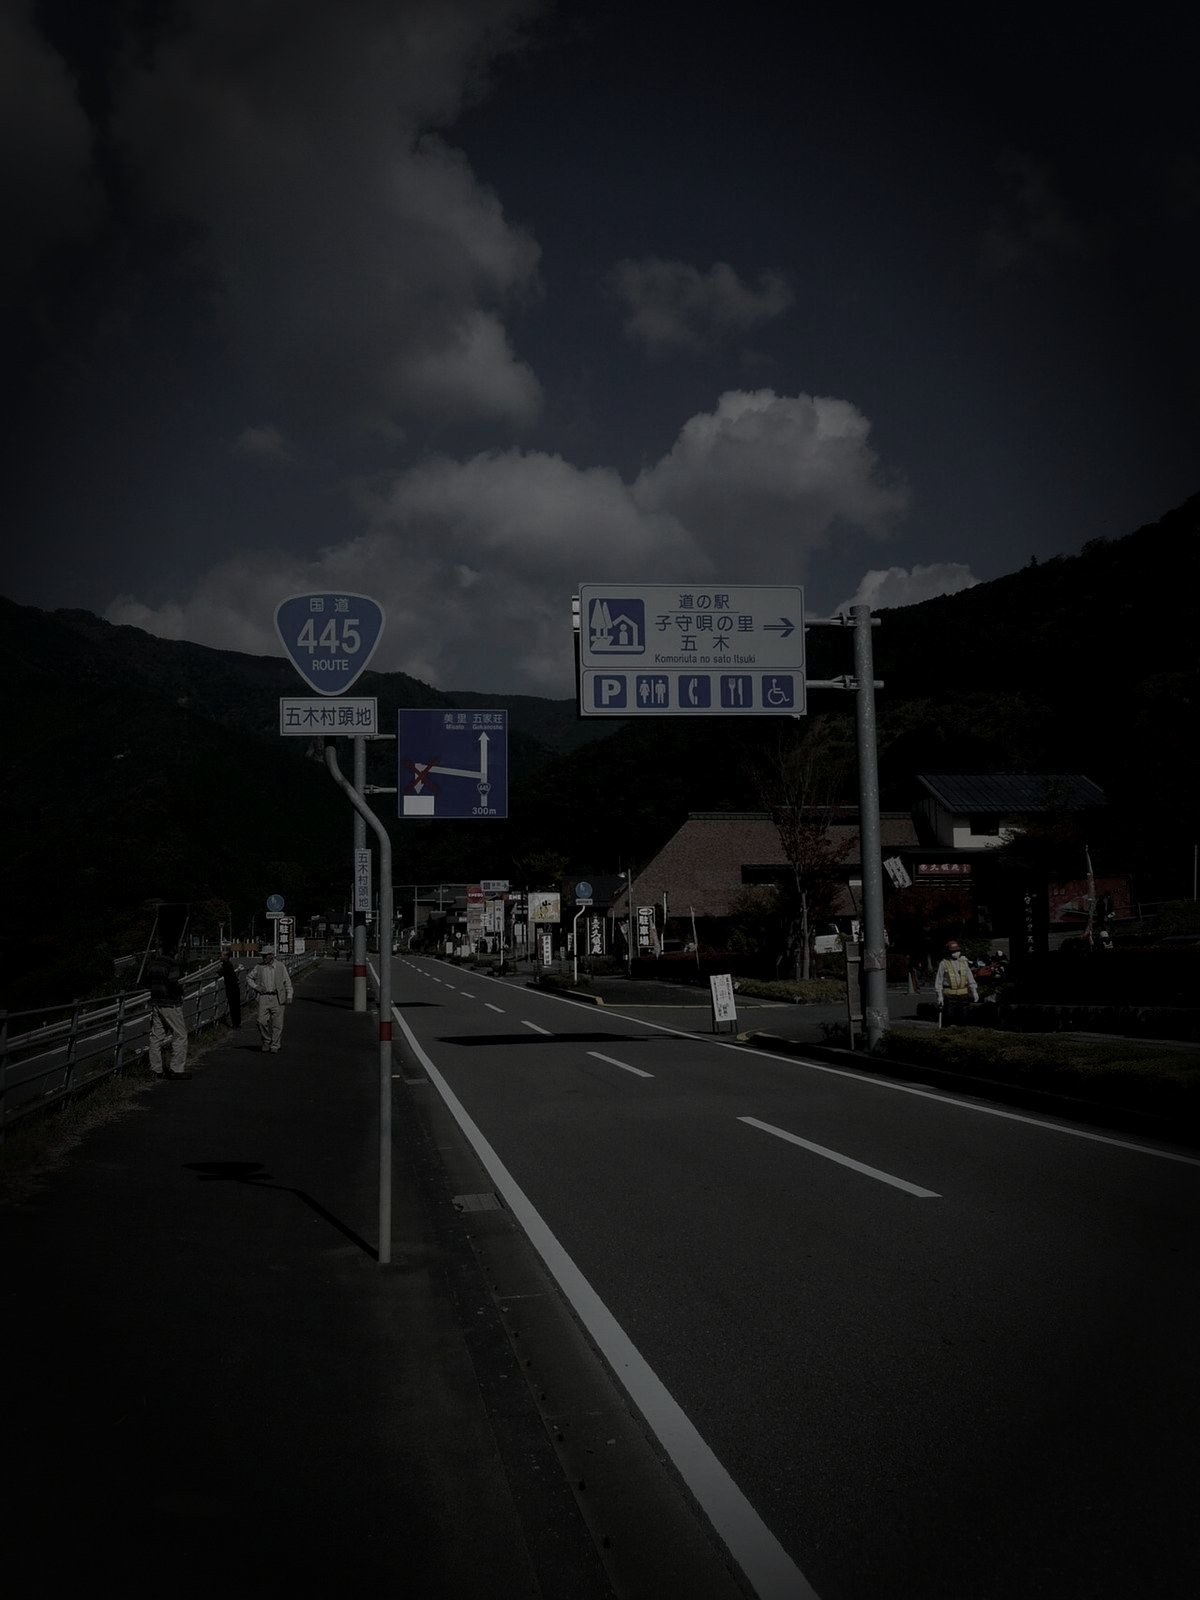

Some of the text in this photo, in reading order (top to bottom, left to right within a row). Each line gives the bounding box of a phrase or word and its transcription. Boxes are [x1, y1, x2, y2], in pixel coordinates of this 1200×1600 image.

[309, 598, 350, 613] 国道
[679, 594, 730, 609] 道の駅
[655, 615, 754, 632] 子守唄の里
[297, 618, 361, 654] 445
[680, 634, 730, 652] 五木
[312, 659, 349, 671] ROUTE
[655, 654, 755, 664] Komoriuta no sato Itsuki
[601, 679, 621, 705] P
[285, 706, 372, 727] 五木村頭地
[472, 713, 503, 724] 五家荘
[472, 807, 497, 815] 300m
[358, 852, 368, 907] 五木村頭地
